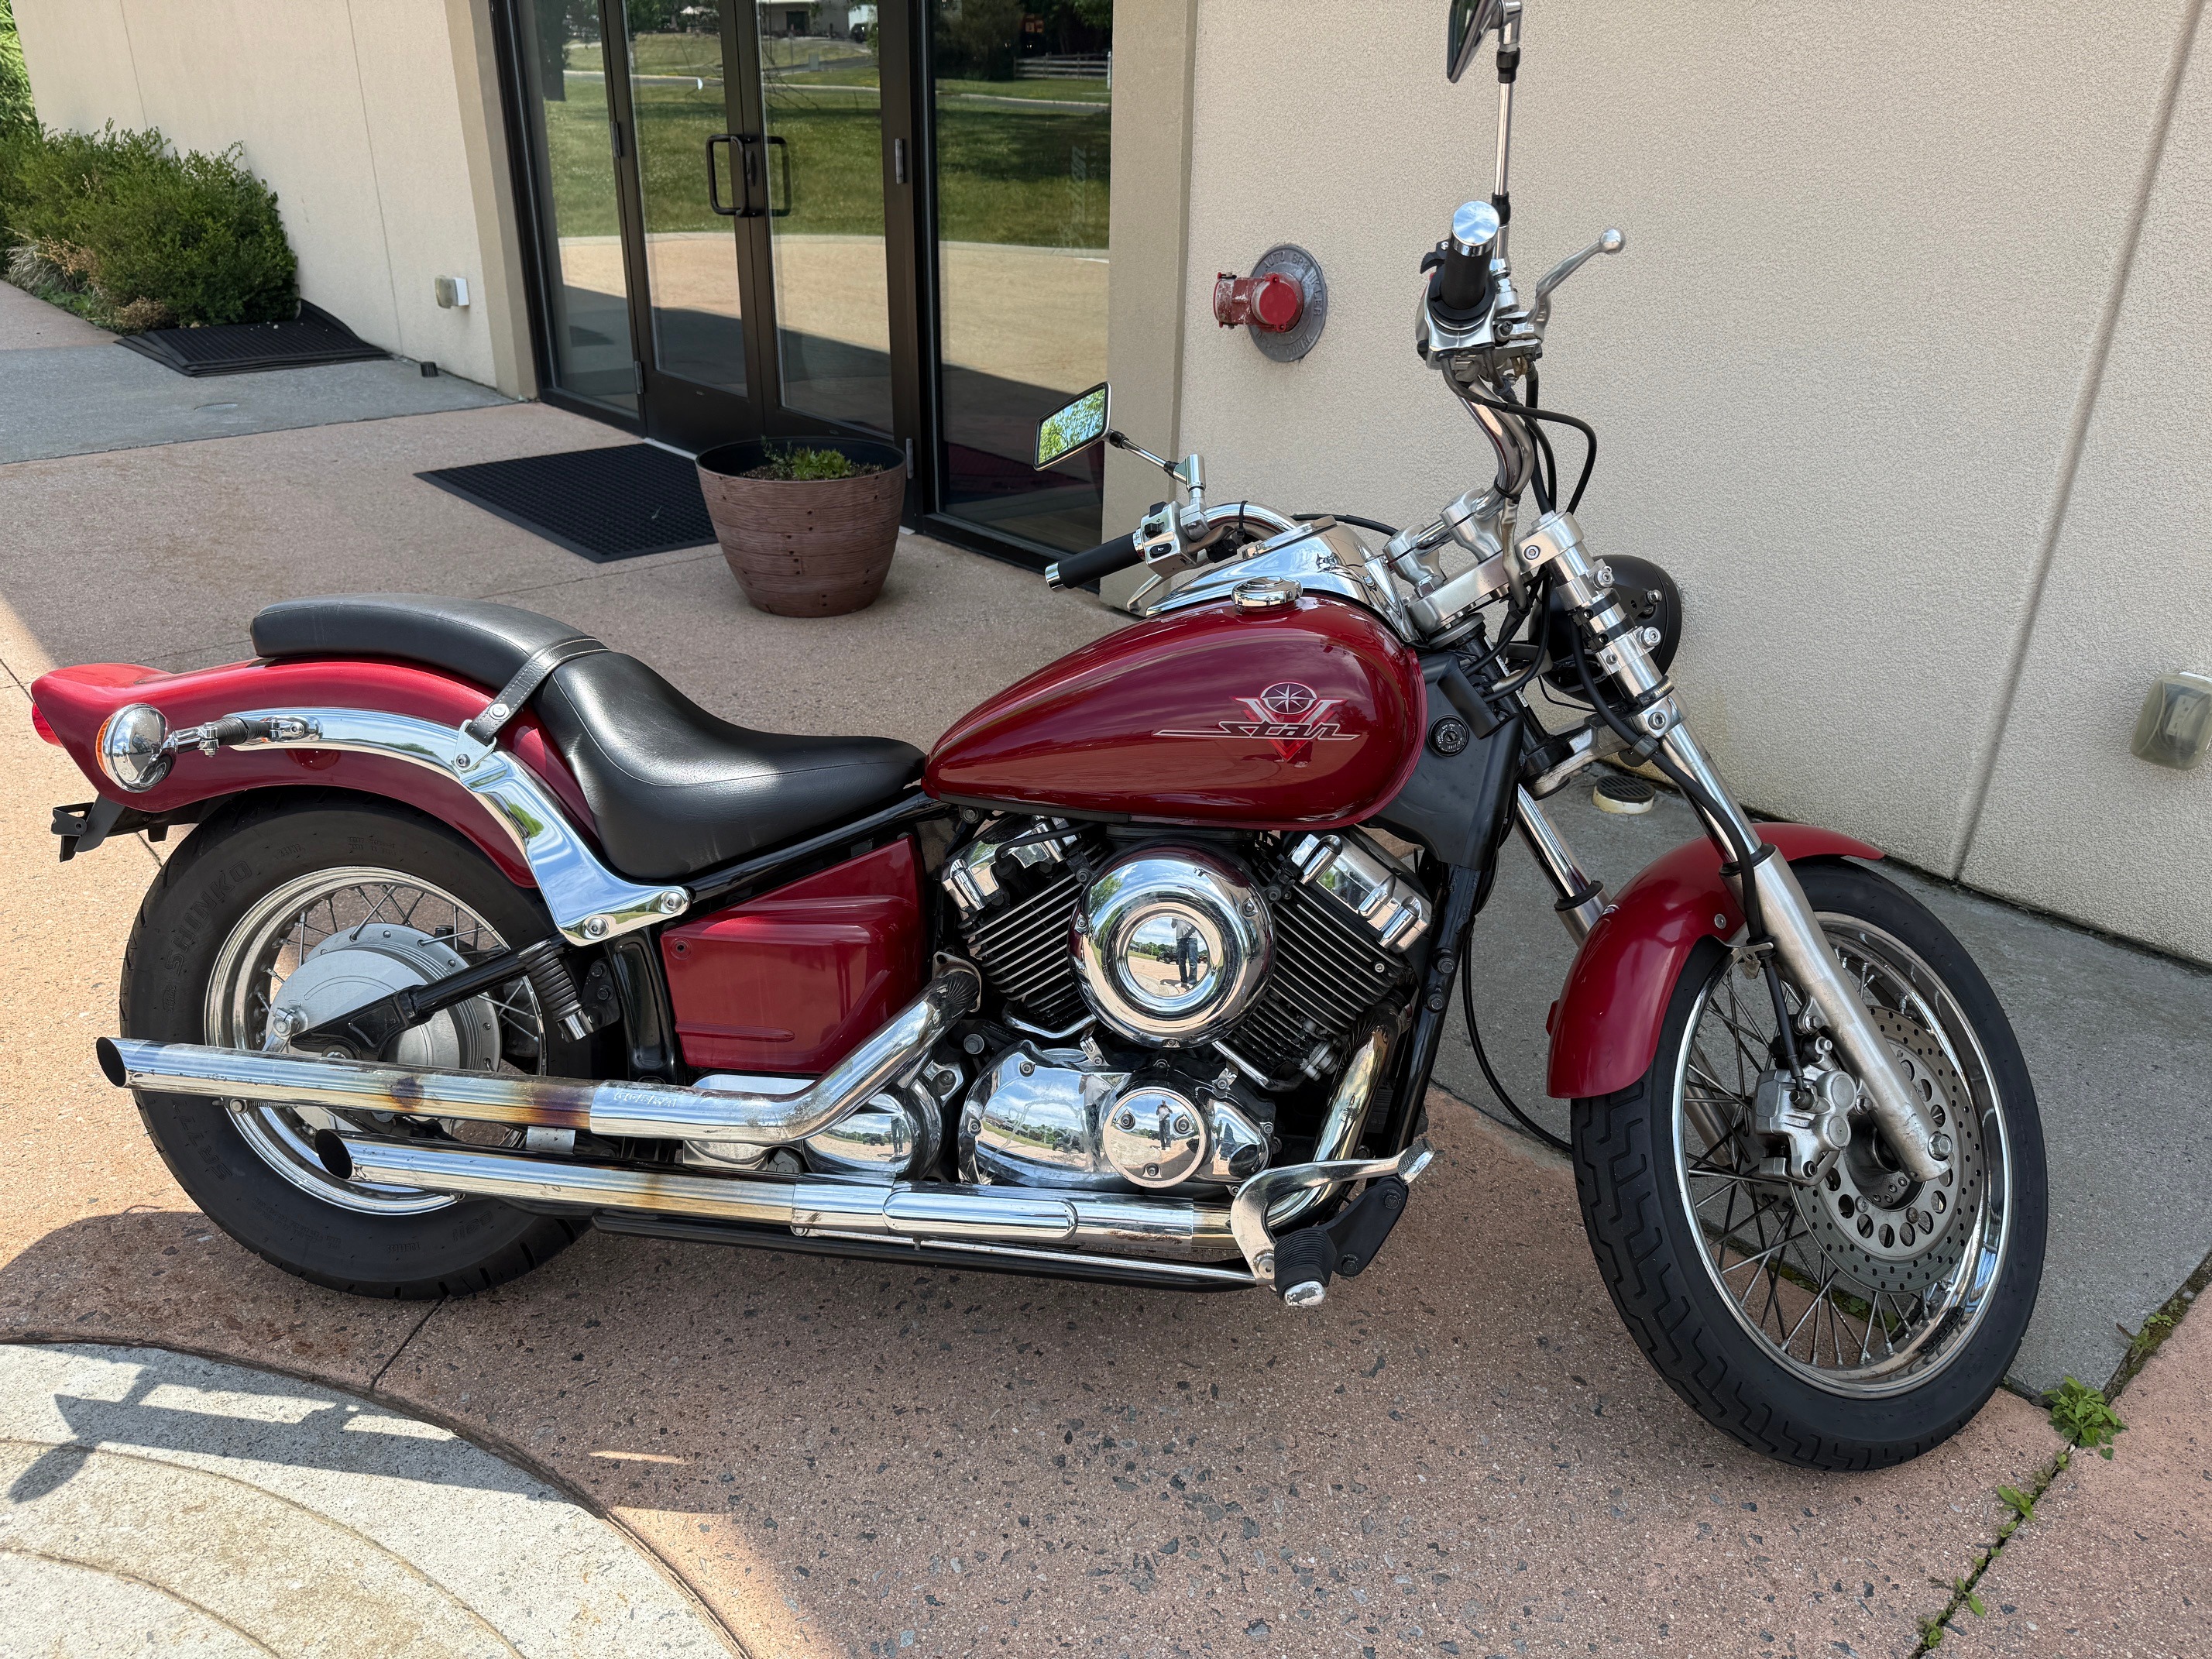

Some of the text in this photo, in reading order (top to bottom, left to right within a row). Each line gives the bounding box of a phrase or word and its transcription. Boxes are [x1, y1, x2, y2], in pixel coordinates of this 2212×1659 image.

[1265, 251, 1323, 316] AUTO SPRINKLER
[164, 860, 252, 977] SHINKO
